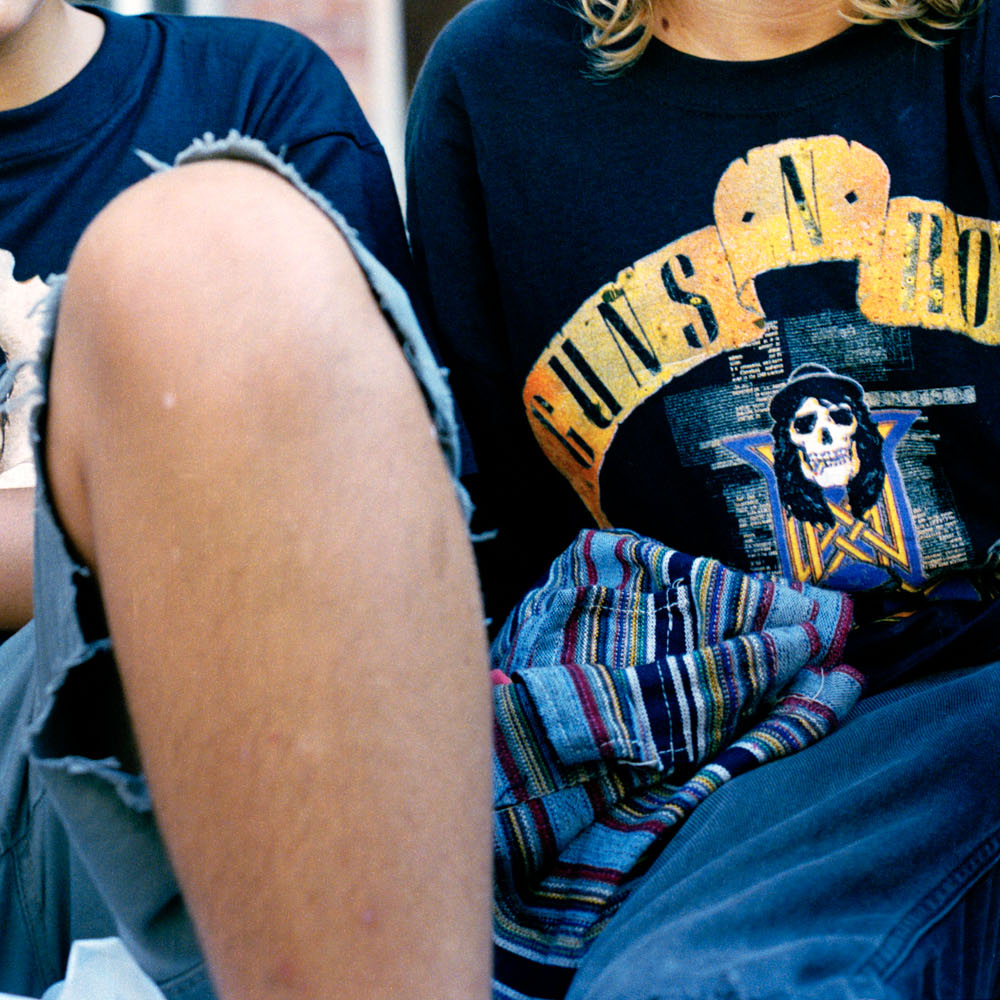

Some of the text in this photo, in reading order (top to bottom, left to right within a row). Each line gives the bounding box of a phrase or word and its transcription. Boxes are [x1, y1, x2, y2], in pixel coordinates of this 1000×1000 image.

[530, 254, 720, 469] GUNS
[779, 151, 824, 252] N
[900, 210, 1000, 329] RO
